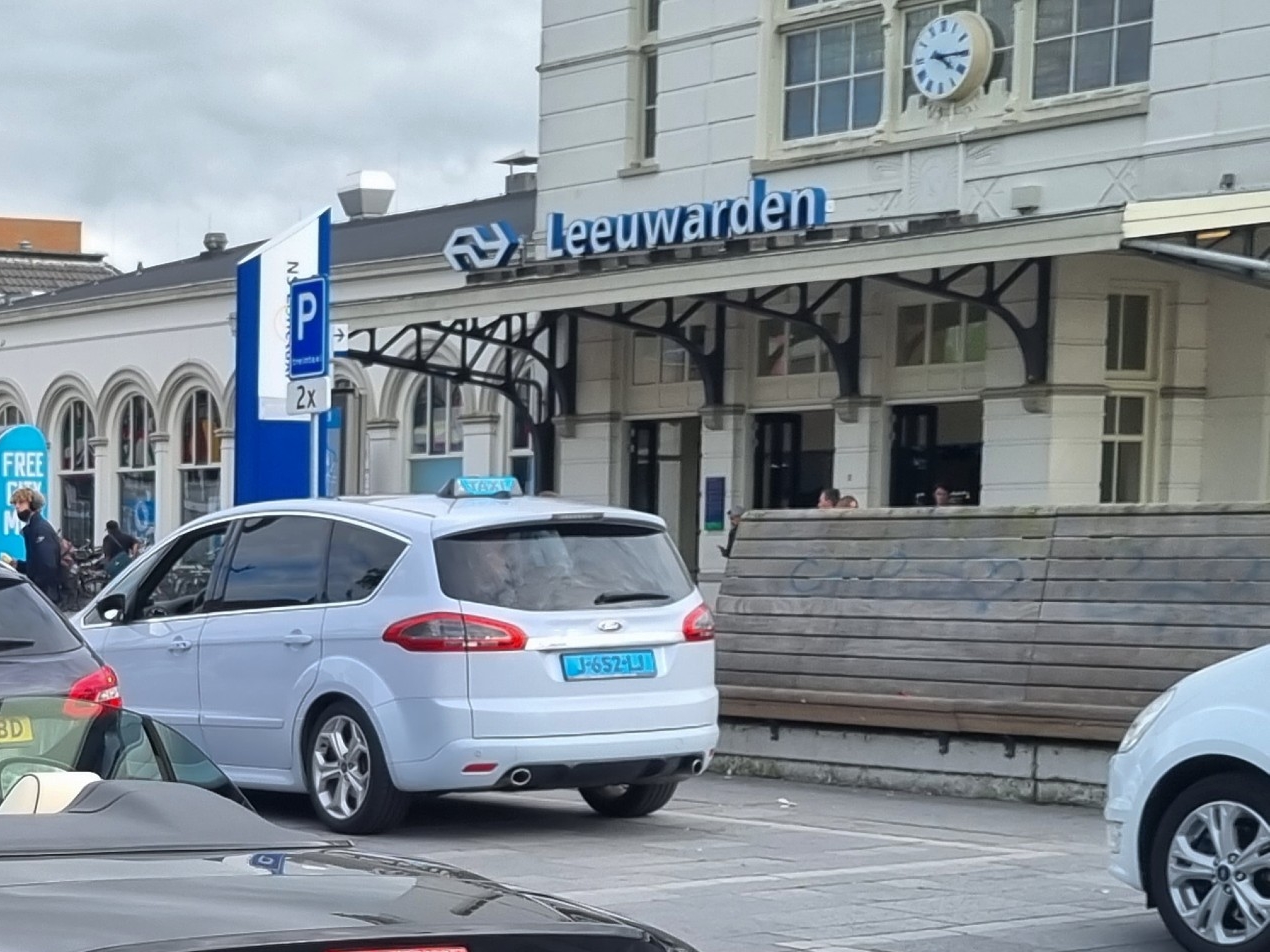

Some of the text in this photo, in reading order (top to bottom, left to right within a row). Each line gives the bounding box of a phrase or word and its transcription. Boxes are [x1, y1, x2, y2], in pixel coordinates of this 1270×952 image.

[546, 178, 826, 258] Leeuwarden
[297, 292, 318, 341] P
[296, 385, 316, 409] 2x
[2, 452, 44, 477] FREE
